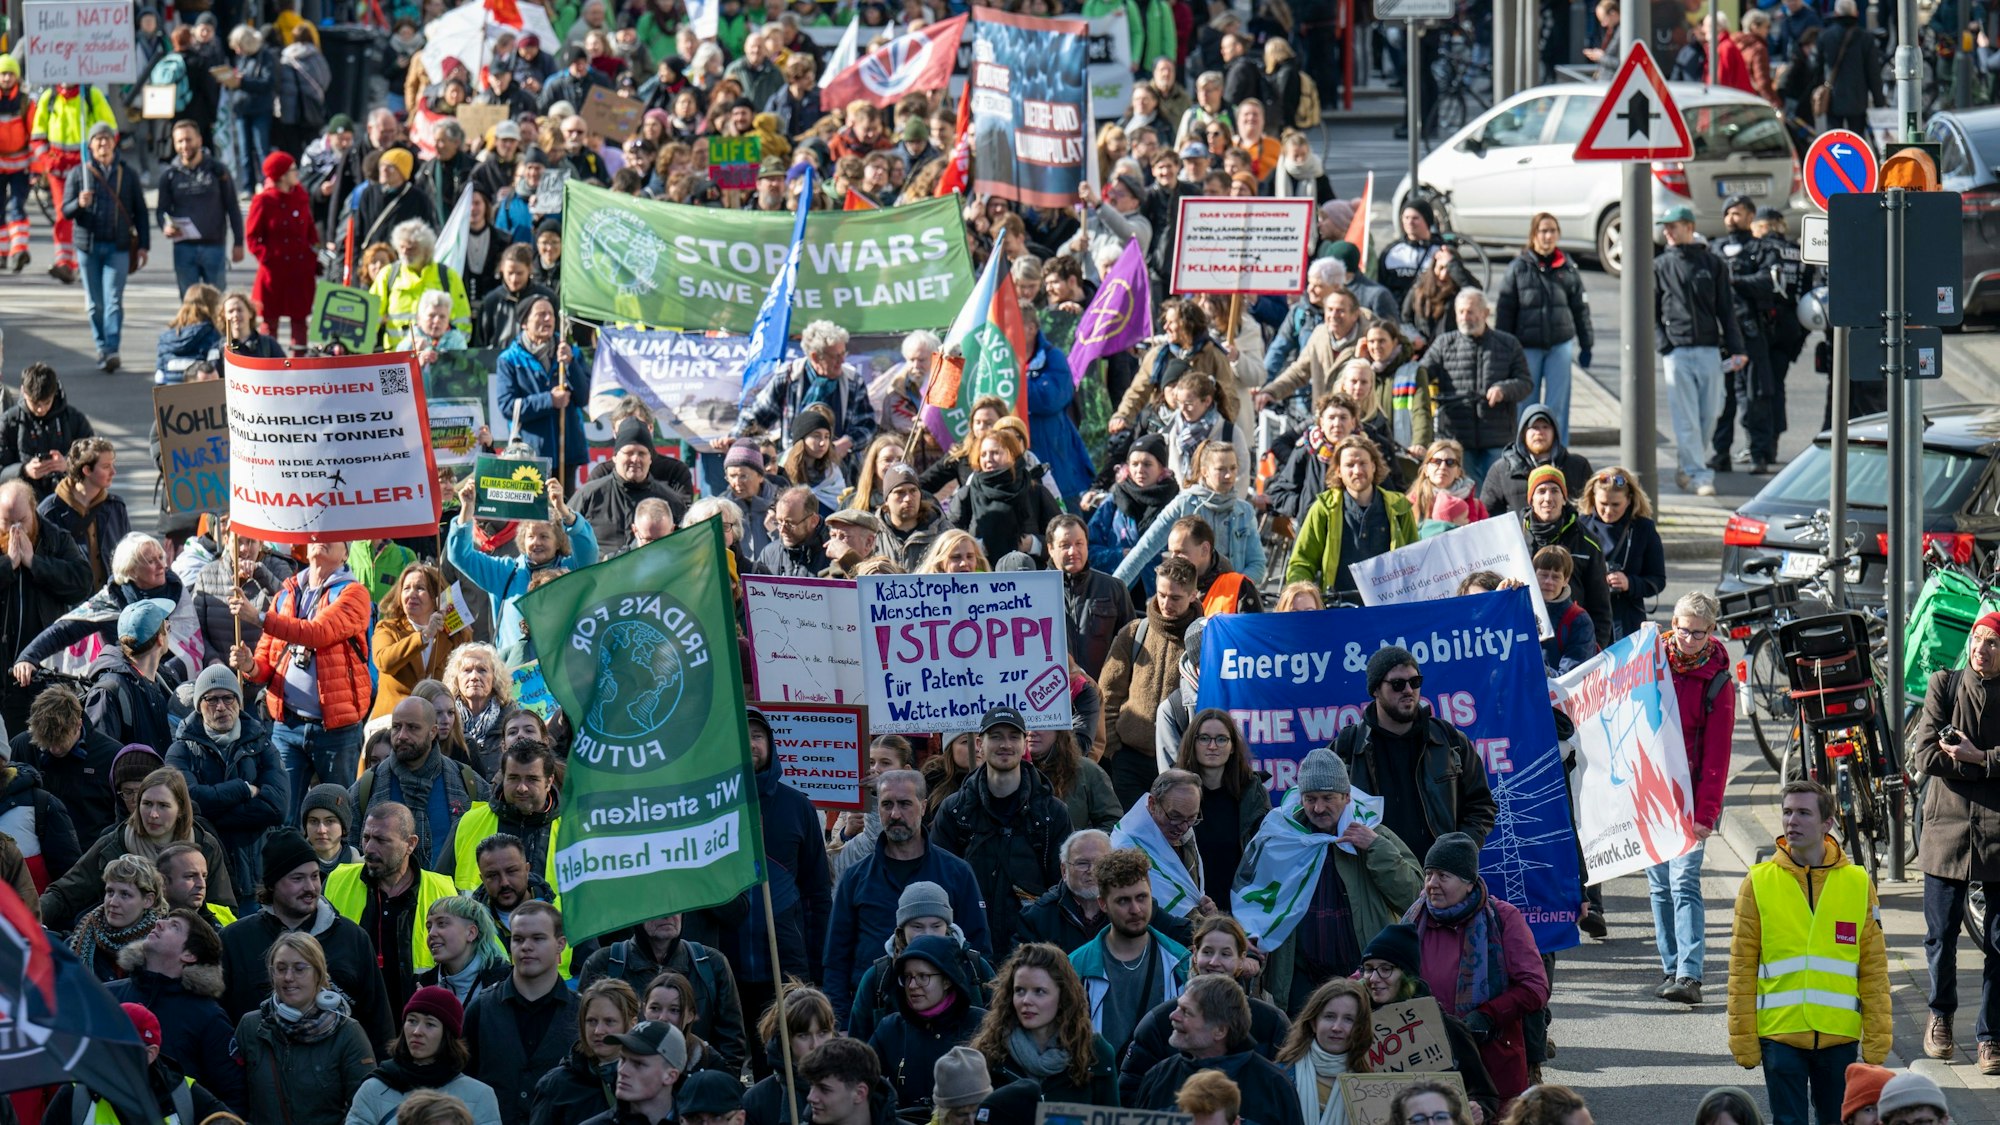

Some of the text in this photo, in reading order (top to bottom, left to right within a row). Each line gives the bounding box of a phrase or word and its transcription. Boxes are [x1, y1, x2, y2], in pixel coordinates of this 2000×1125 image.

[77, 5, 129, 26] NATO!
[674, 226, 949, 275] STOP WARS
[1187, 264, 1293, 273] KLIMAKILLER
[678, 276, 753, 304] SAVE
[833, 272, 954, 309] PLANET
[639, 355, 722, 380] FÜHRT
[230, 379, 374, 396] DAS VERSPRÜHEN
[230, 407, 393, 425] VON JÄHRLICH BIS ZU
[236, 428, 317, 443] MILLIONEN
[323, 427, 404, 442] TONNEN
[171, 447, 213, 473] NUR
[278, 459, 291, 467] IN
[316, 451, 411, 466] ATMOSPHÄRE
[169, 469, 231, 512] ÖPN
[481, 479, 501, 488] KLIMA
[234, 483, 413, 508] KLIMAKILLER
[489, 490, 532, 501] JOBS SICHERN
[1371, 562, 1420, 587] Preisfrage:
[1378, 552, 1510, 602] Wo wird die Gentech 2.0 künftig
[749, 586, 766, 597] Das
[875, 577, 1016, 602] Katastrophen von
[870, 593, 1032, 623] Menschen gemacht
[846, 624, 857, 632] 20
[1220, 648, 1332, 684] Energy
[1343, 641, 1368, 673] &
[921, 667, 984, 692] Patente
[999, 669, 1029, 684] zur
[1031, 674, 1062, 704] Patent
[764, 714, 790, 722] ENT
[1228, 708, 1296, 744] THE
[1438, 690, 1478, 727] IS
[775, 740, 857, 750] RWAFFEN
[778, 755, 798, 763] ZE
[1521, 911, 1576, 924] TEIGNEN
[1837, 934, 1855, 942] ver.di
[1368, 1020, 1424, 1068] NOT
